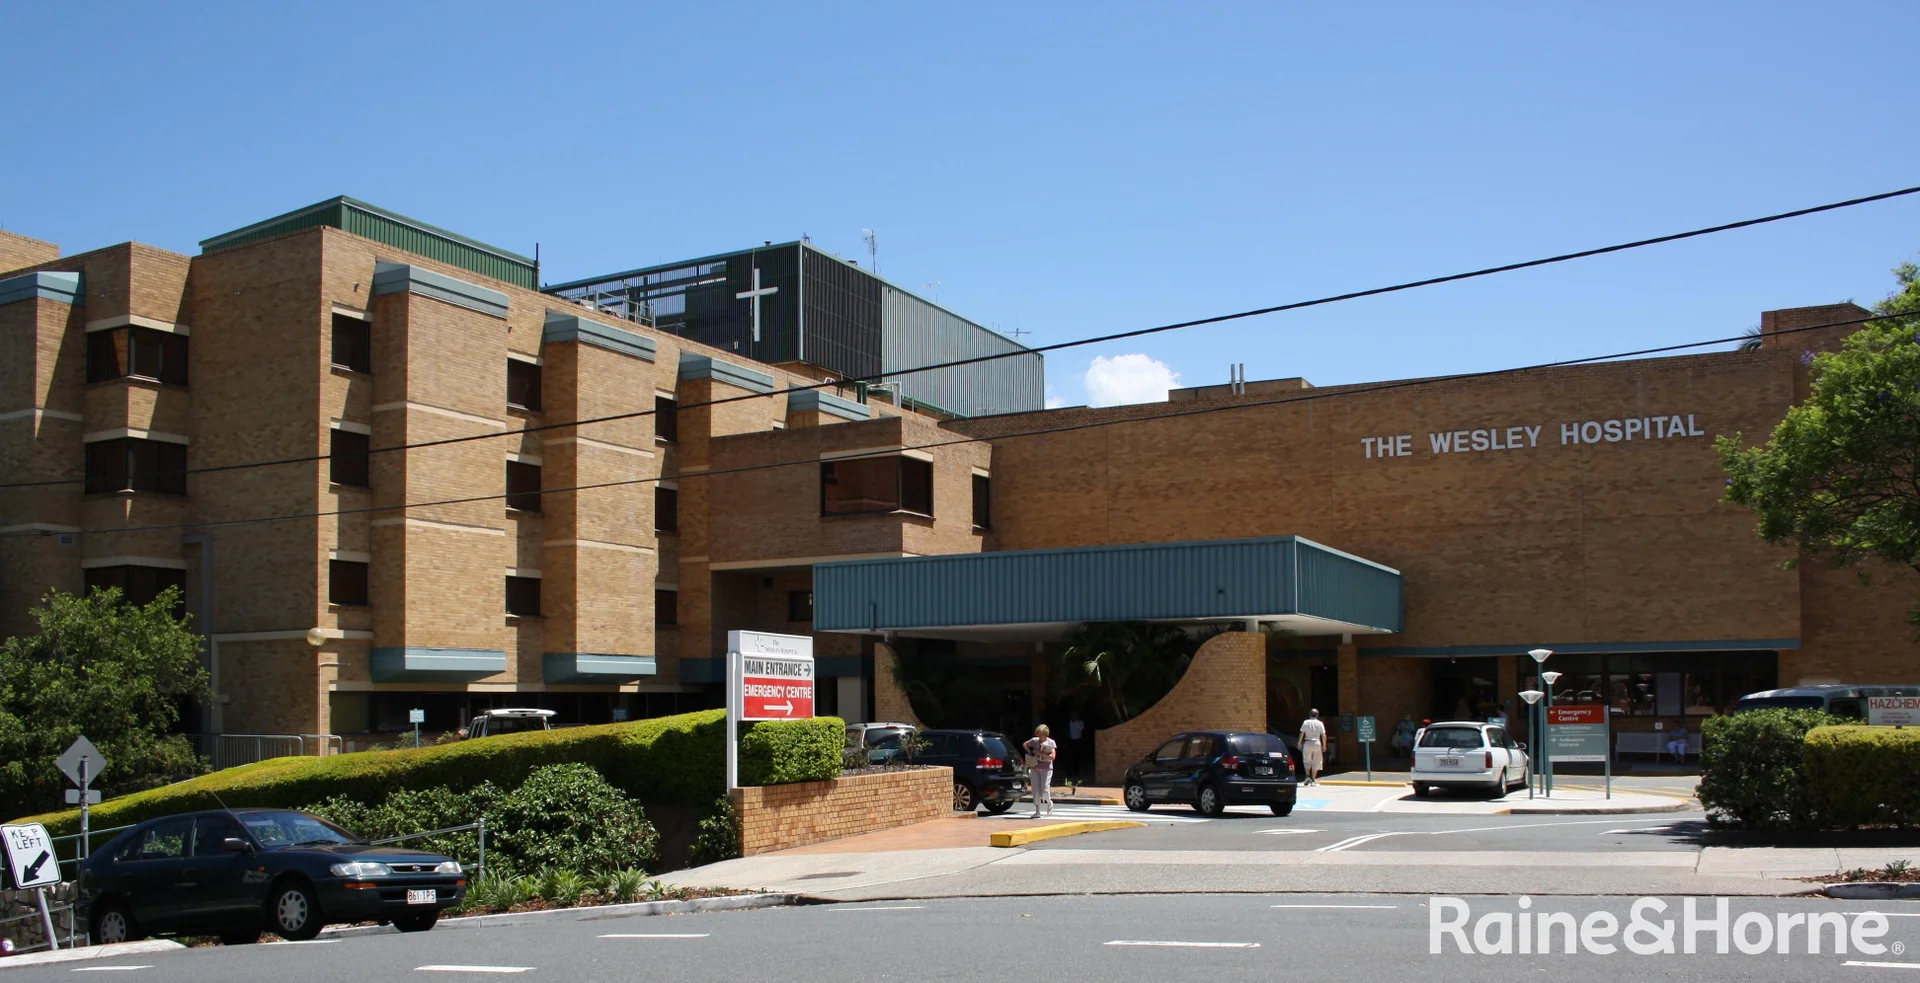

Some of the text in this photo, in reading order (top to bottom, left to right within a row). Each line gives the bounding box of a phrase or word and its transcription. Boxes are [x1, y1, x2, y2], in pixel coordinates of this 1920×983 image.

[1361, 414, 1705, 458] THE WESLEY HOSPITAL
[744, 660, 802, 676] MAIN ENTRANCE
[744, 684, 812, 699] EMERGENCY CENTRE
[1870, 698, 1920, 709] HAZCHEM
[15, 837, 42, 850] LEFT
